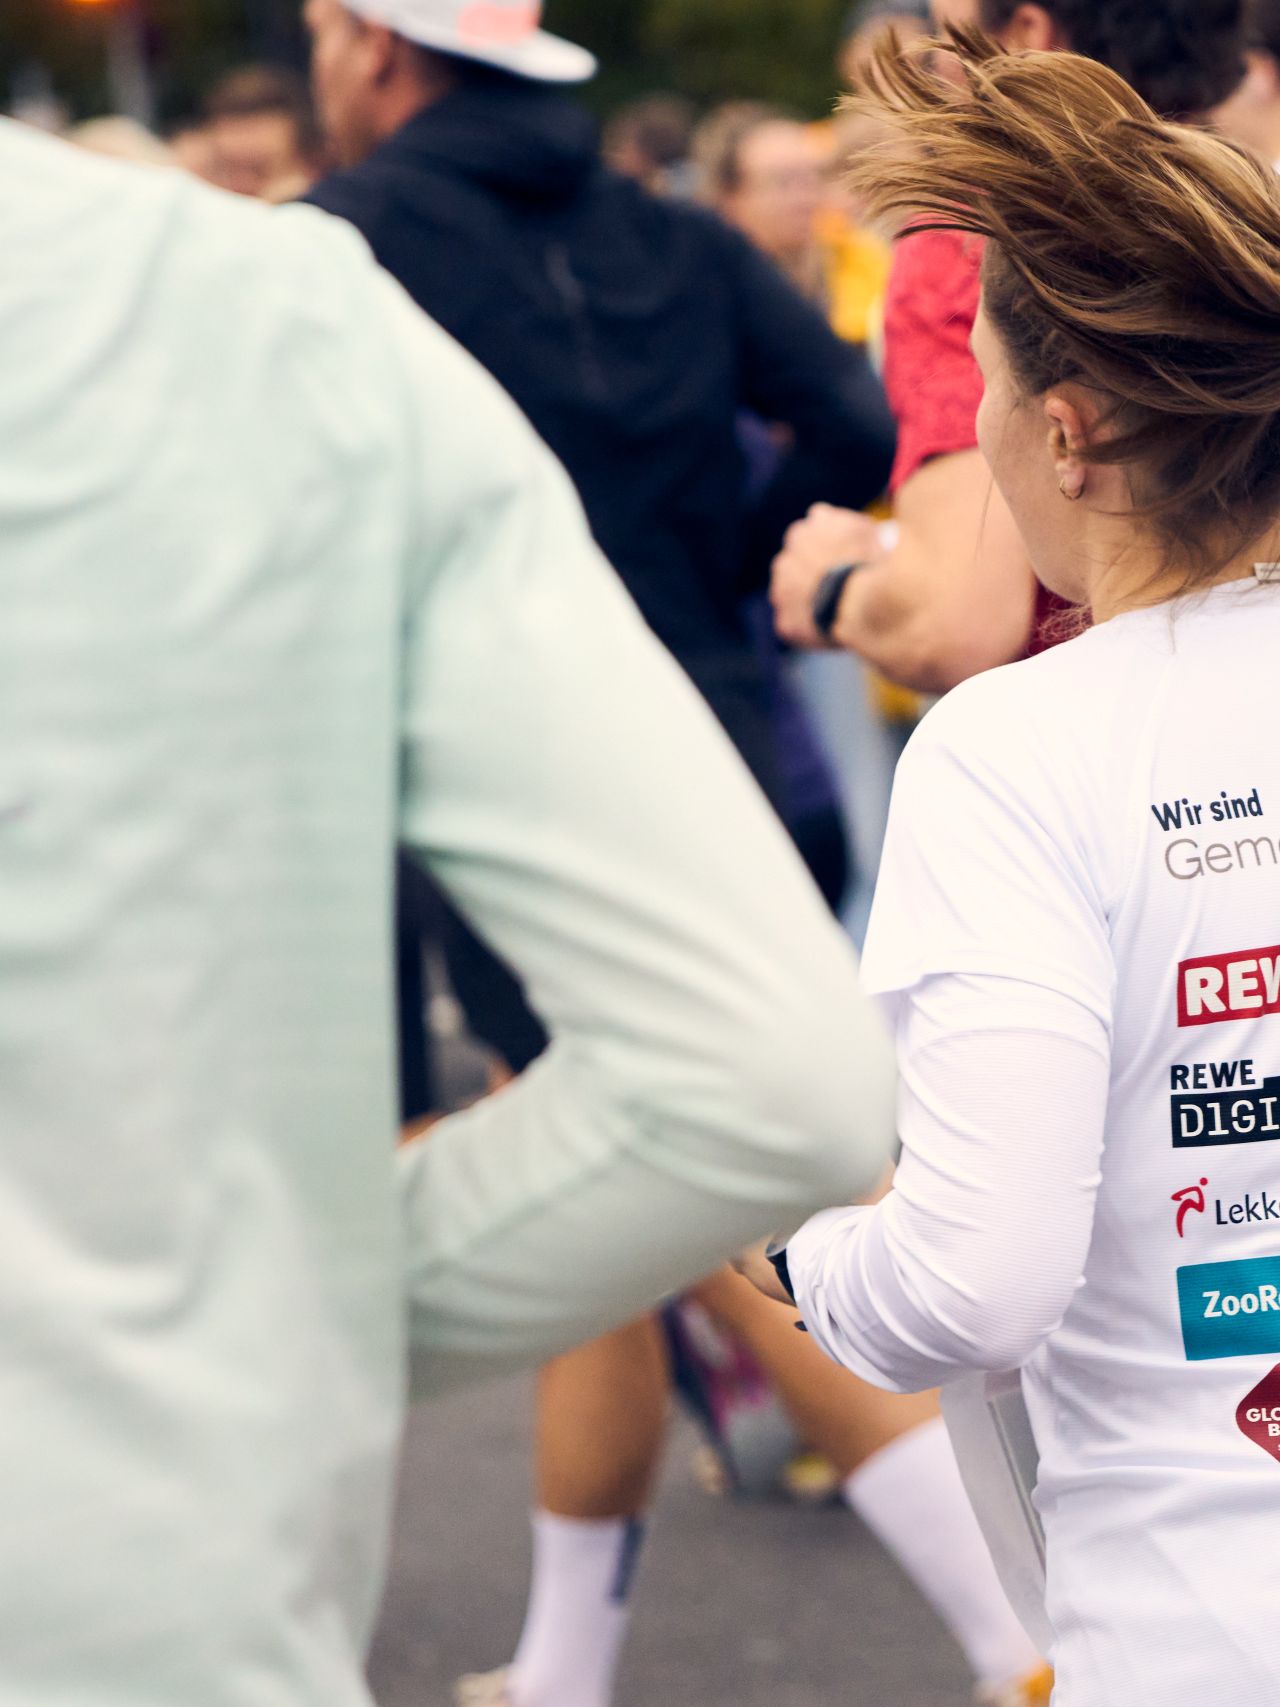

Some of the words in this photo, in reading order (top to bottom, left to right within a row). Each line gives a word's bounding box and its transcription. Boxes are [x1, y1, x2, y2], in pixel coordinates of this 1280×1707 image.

[1151, 799, 1201, 831] Wir
[1210, 788, 1264, 821] sind
[1170, 1059, 1256, 1090] REWE
